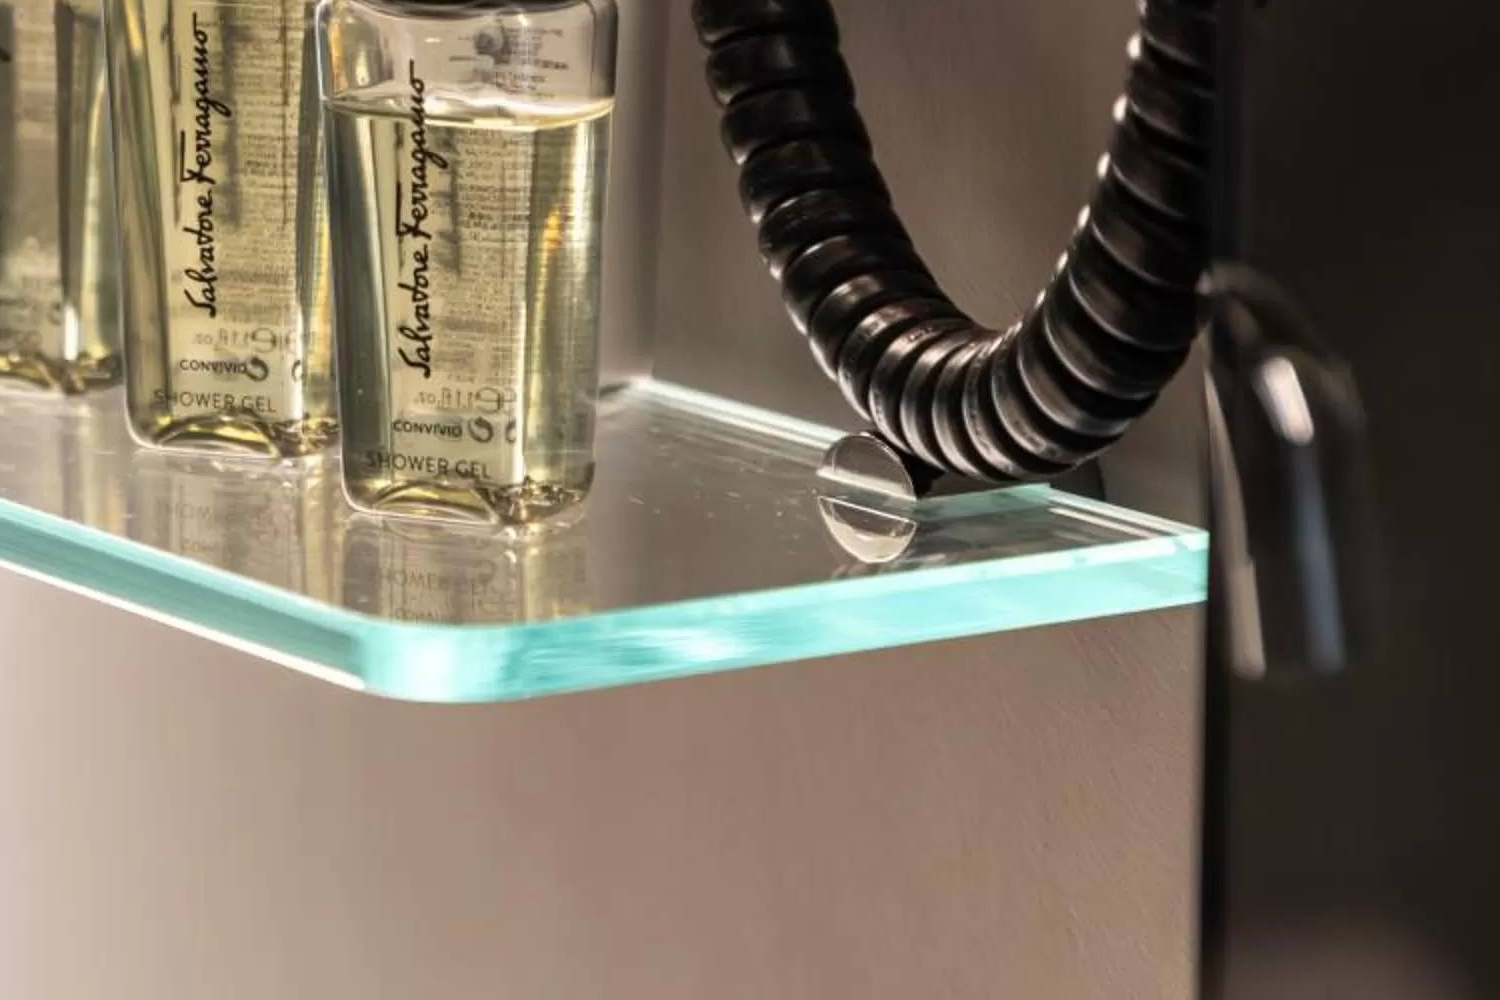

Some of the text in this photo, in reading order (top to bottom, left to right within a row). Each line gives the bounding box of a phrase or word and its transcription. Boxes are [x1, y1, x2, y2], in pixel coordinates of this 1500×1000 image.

[179, 11, 232, 319] Salvatore Ferragamo
[395, 57, 448, 380] Salvatore Ferragamo
[179, 358, 248, 375] CONVIVIO
[153, 388, 277, 414] SHOWER GEL
[392, 419, 463, 438] CONVIVIO
[367, 450, 493, 479] SHOWER GEL
